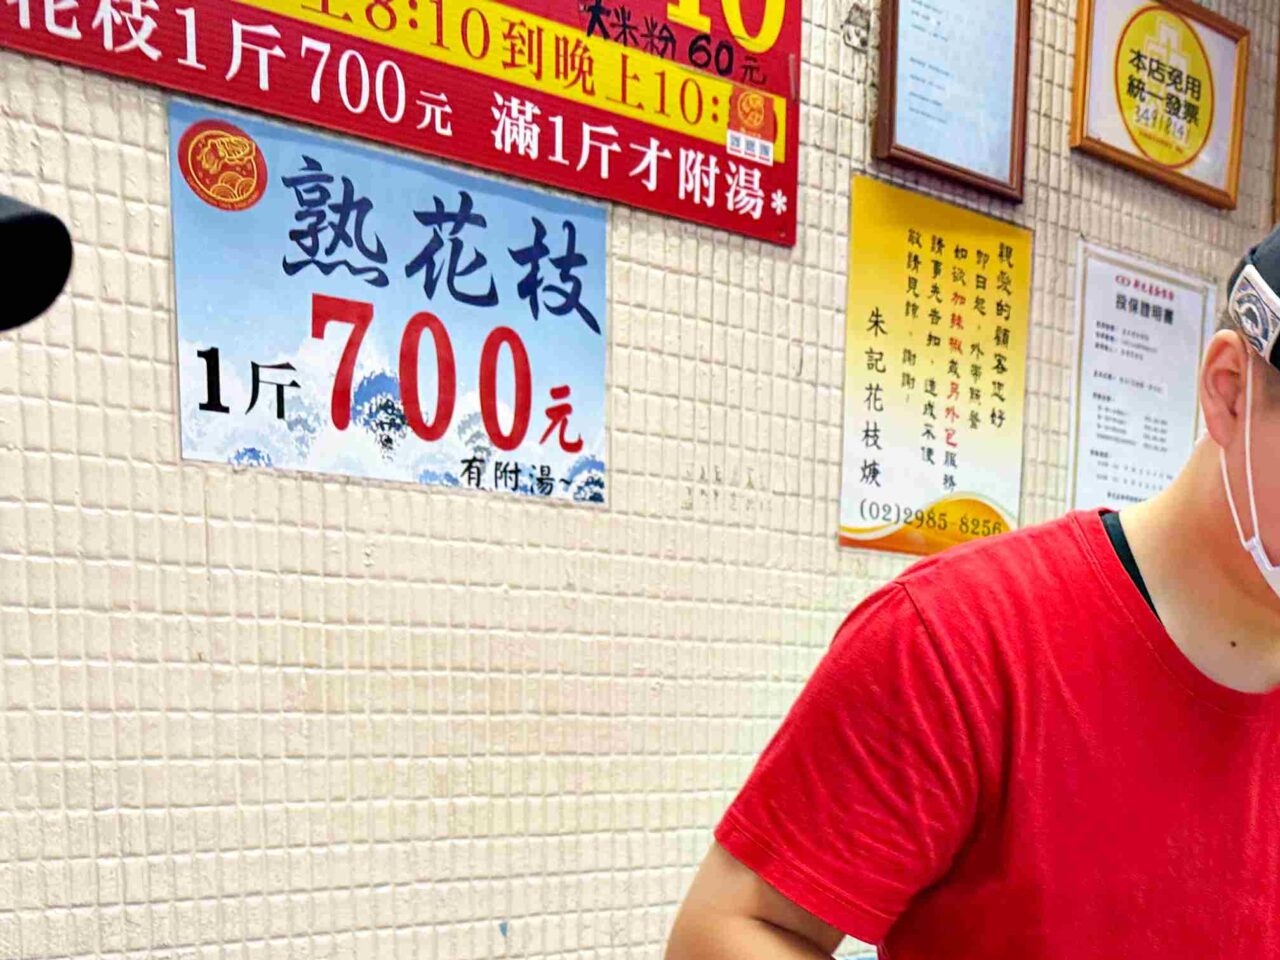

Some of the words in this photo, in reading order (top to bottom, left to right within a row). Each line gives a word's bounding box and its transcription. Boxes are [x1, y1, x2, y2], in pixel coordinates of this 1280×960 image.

[300, 0, 778, 143] 8:10到晚上10:
[1127, 74, 1201, 128] 統一發票
[1128, 48, 1202, 102] 本店免用
[280, 154, 602, 336] 熟花枝
[989, 241, 1015, 429] 親愛的顧客您好
